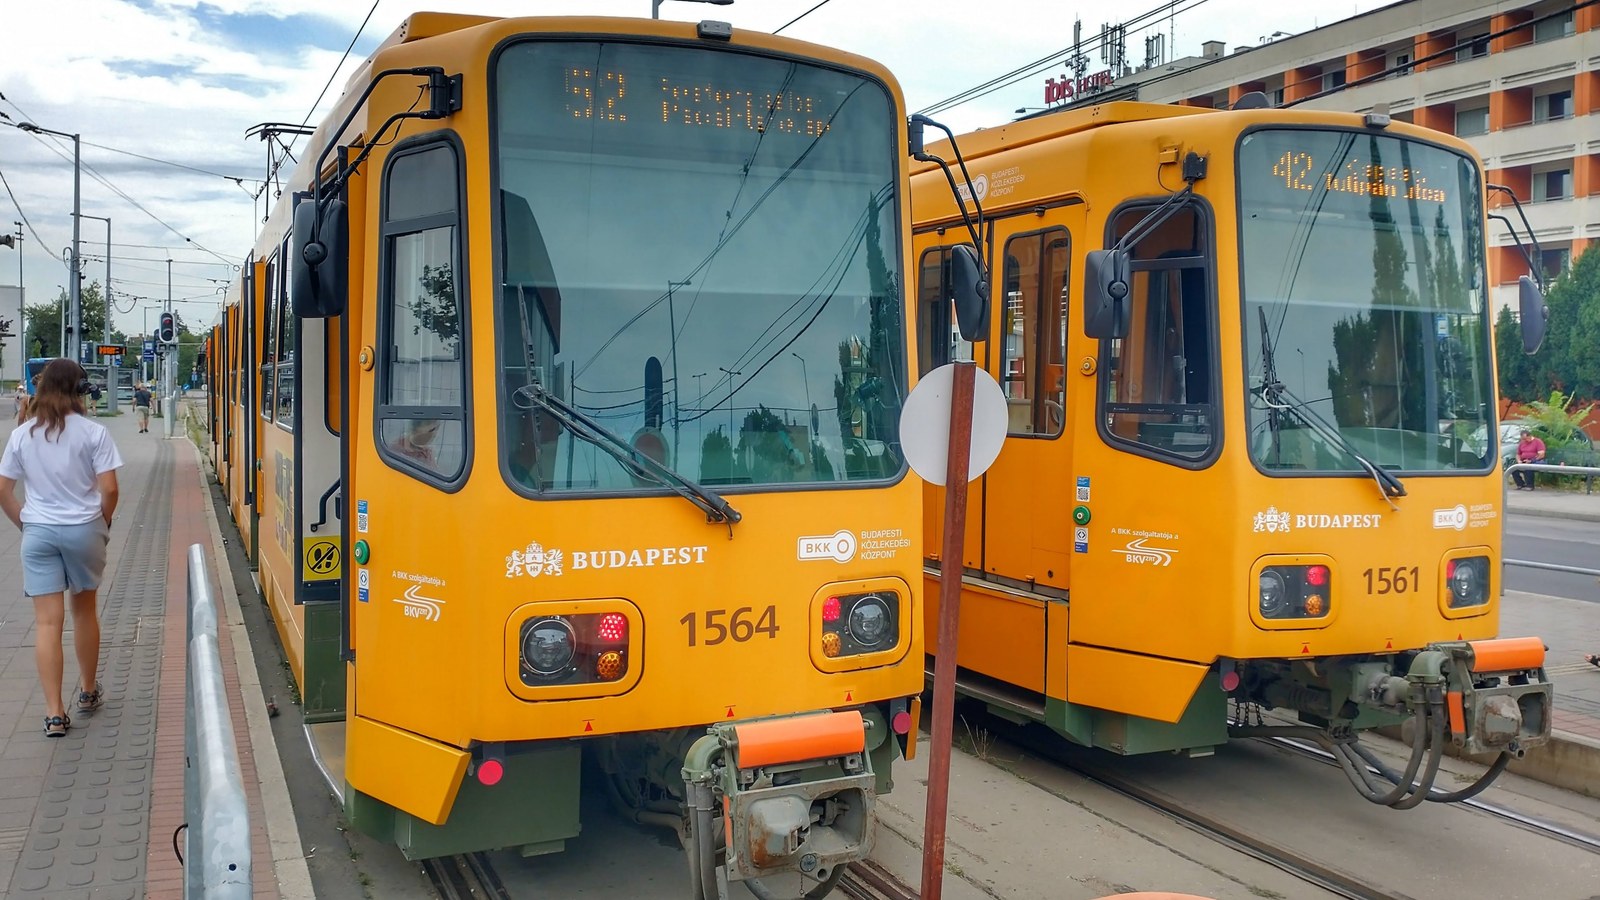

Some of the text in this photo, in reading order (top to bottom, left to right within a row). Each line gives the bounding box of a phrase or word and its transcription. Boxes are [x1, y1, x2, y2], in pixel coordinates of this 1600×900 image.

[1045, 74, 1075, 104] ibis
[1273, 151, 1313, 191] 42
[1296, 514, 1382, 528] BUDAPEST
[861, 529, 902, 539] BUDAPESTI
[806, 542, 831, 554] BKK
[861, 537, 911, 550] KÖZLEKEDÉSI
[571, 546, 708, 569] BUDAPEST
[861, 549, 897, 560] KÖZPONT
[1363, 566, 1419, 595] 1561
[680, 605, 780, 647] 1564
